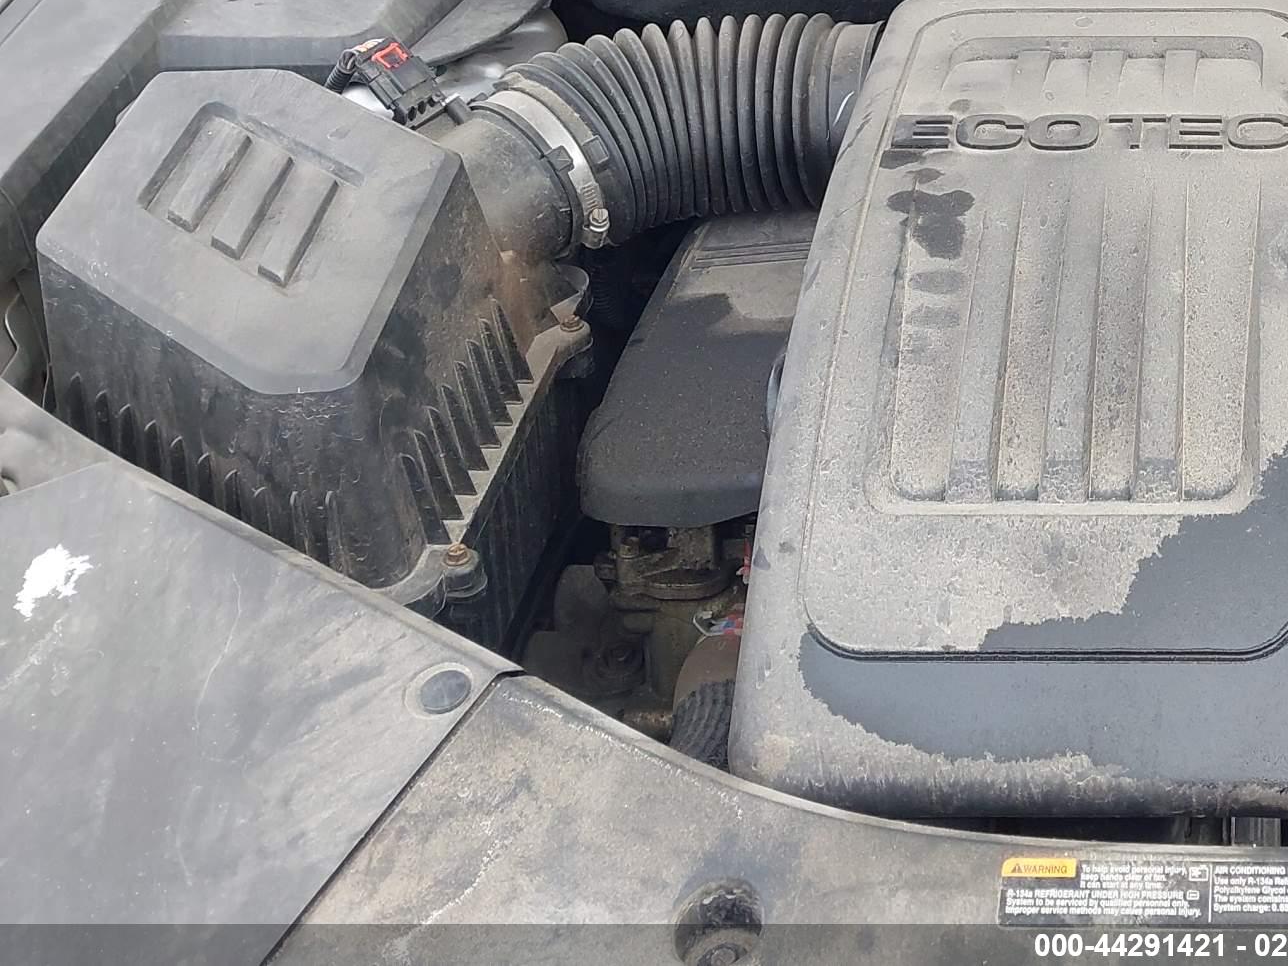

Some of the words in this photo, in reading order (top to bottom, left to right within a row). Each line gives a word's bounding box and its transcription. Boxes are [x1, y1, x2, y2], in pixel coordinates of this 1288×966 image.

[1024, 866, 1068, 874] WARNING
[1215, 866, 1228, 874] AIR
[1230, 866, 1286, 874] CONDITIONING
[1230, 878, 1246, 887] only
[1035, 890, 1090, 898] REFRIGERANT
[1091, 890, 1118, 898] UNDER
[1120, 890, 1140, 898] HIGH
[1142, 890, 1184, 899] PRESSURE
[1214, 895, 1227, 903] The
[1229, 895, 1256, 904] system
[1258, 895, 1288, 903] contains
[1214, 904, 1241, 913] System
